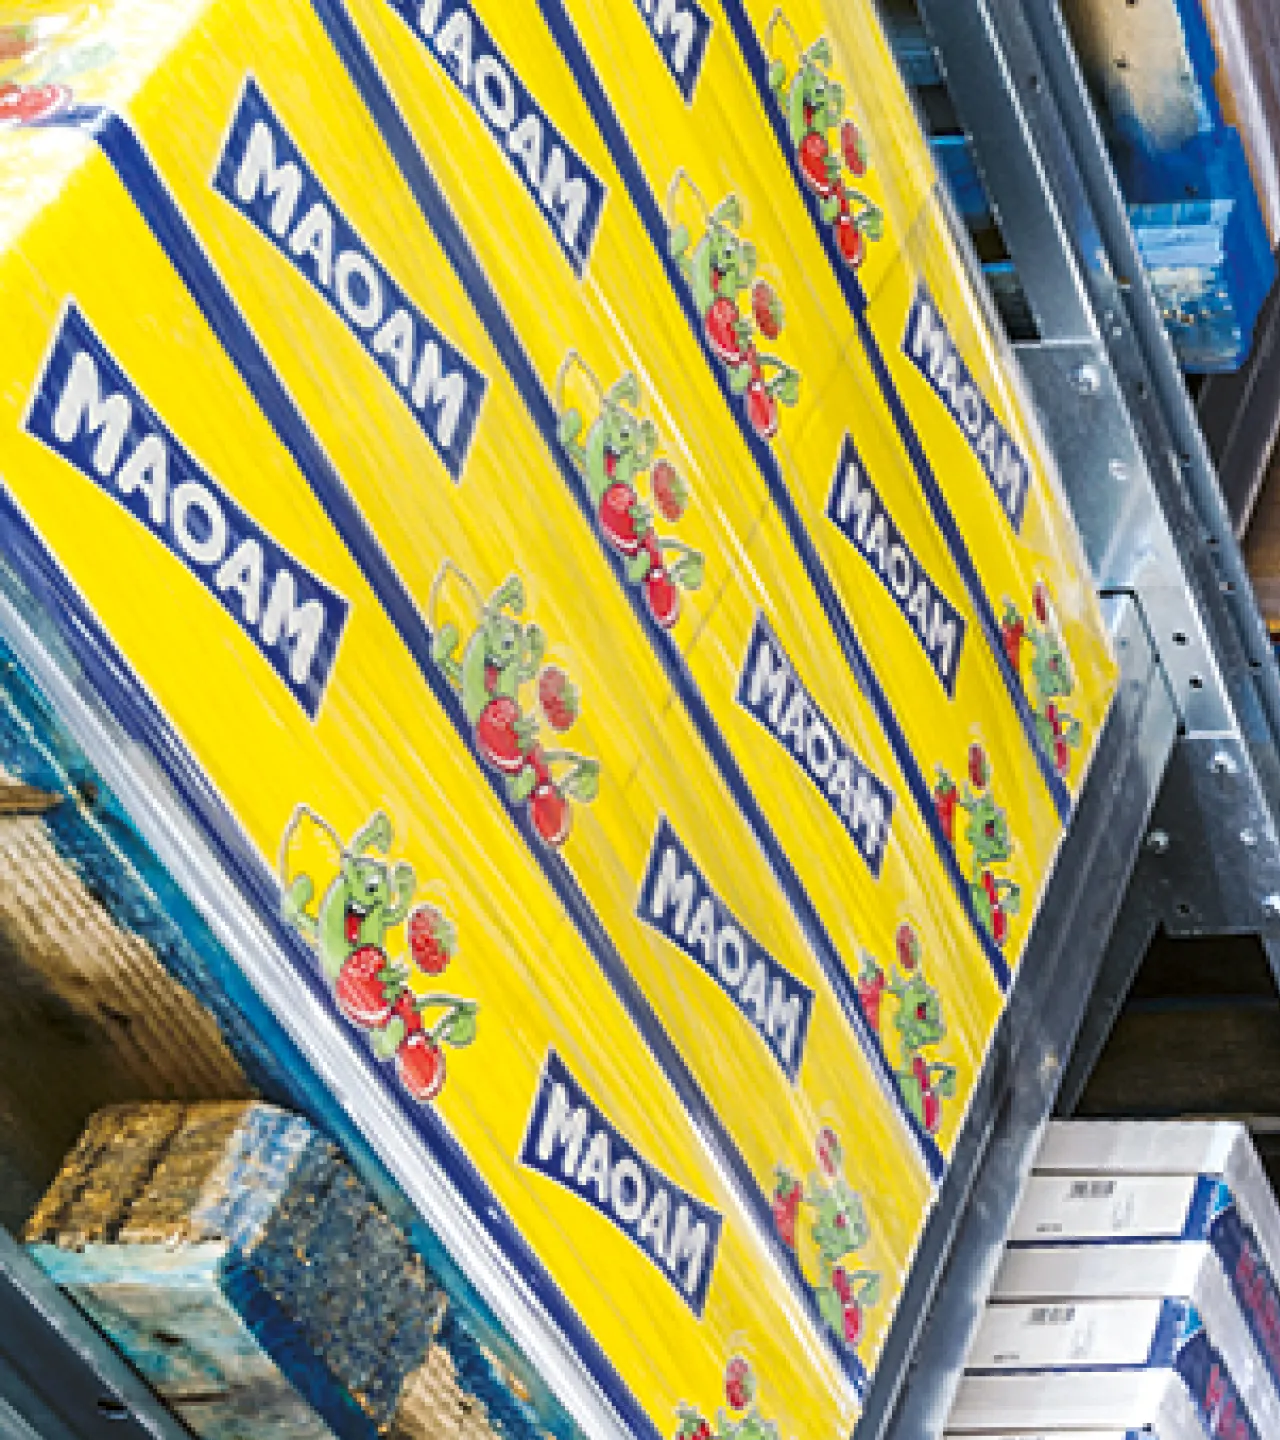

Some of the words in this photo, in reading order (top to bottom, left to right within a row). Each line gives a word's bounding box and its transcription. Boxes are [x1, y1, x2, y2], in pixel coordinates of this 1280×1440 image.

[236, 121, 467, 447] MAOAM
[51, 352, 324, 685] MAOAM
[912, 320, 1026, 517] MAOAM
[836, 464, 956, 677] MAOAM
[747, 652, 886, 854] MAOAM
[650, 848, 802, 1064] MAOAM
[538, 1094, 709, 1297] MAOAM
